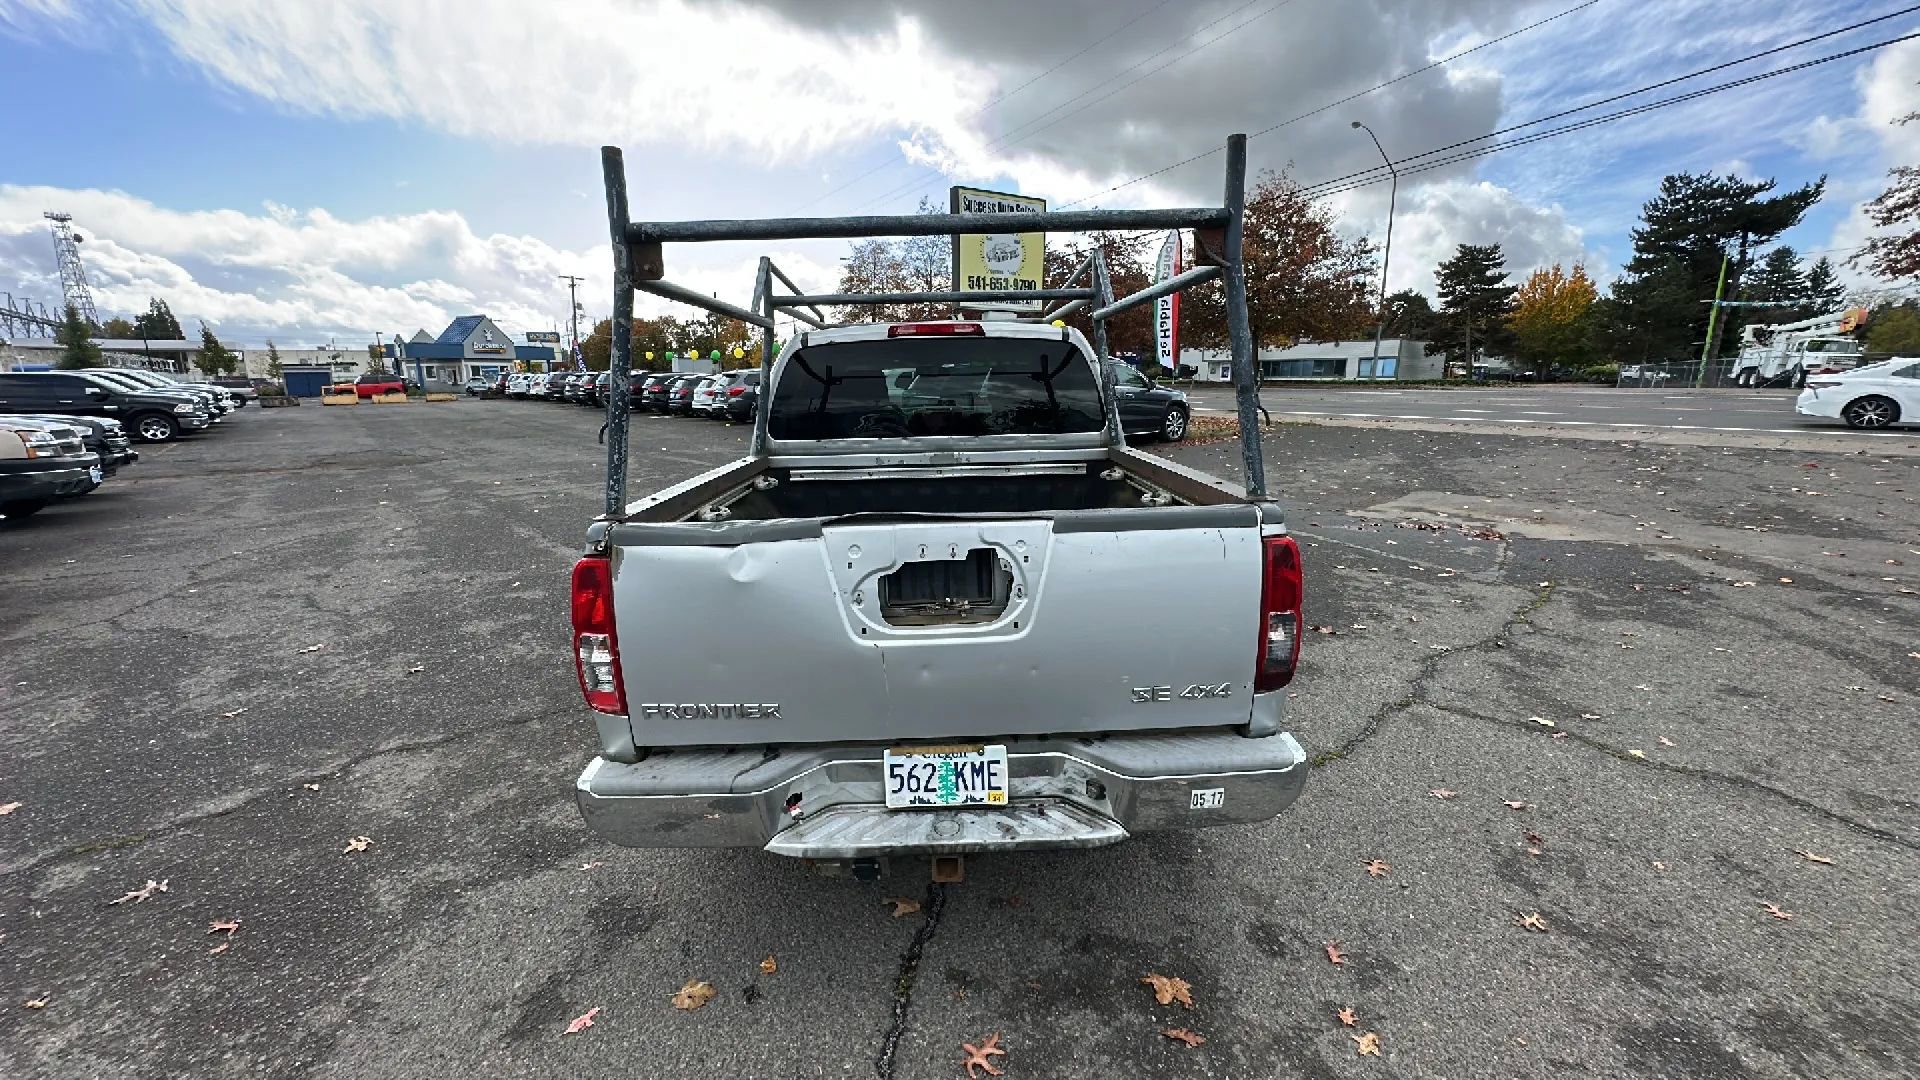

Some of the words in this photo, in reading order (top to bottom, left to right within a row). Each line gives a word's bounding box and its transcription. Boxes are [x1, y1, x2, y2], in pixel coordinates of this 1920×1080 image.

[963, 195, 996, 214] Success
[997, 201, 1014, 213] Auto
[1131, 685, 1171, 703] SE
[641, 703, 783, 720] FRONTIER
[889, 762, 937, 794] 562
[953, 759, 1003, 792] KME
